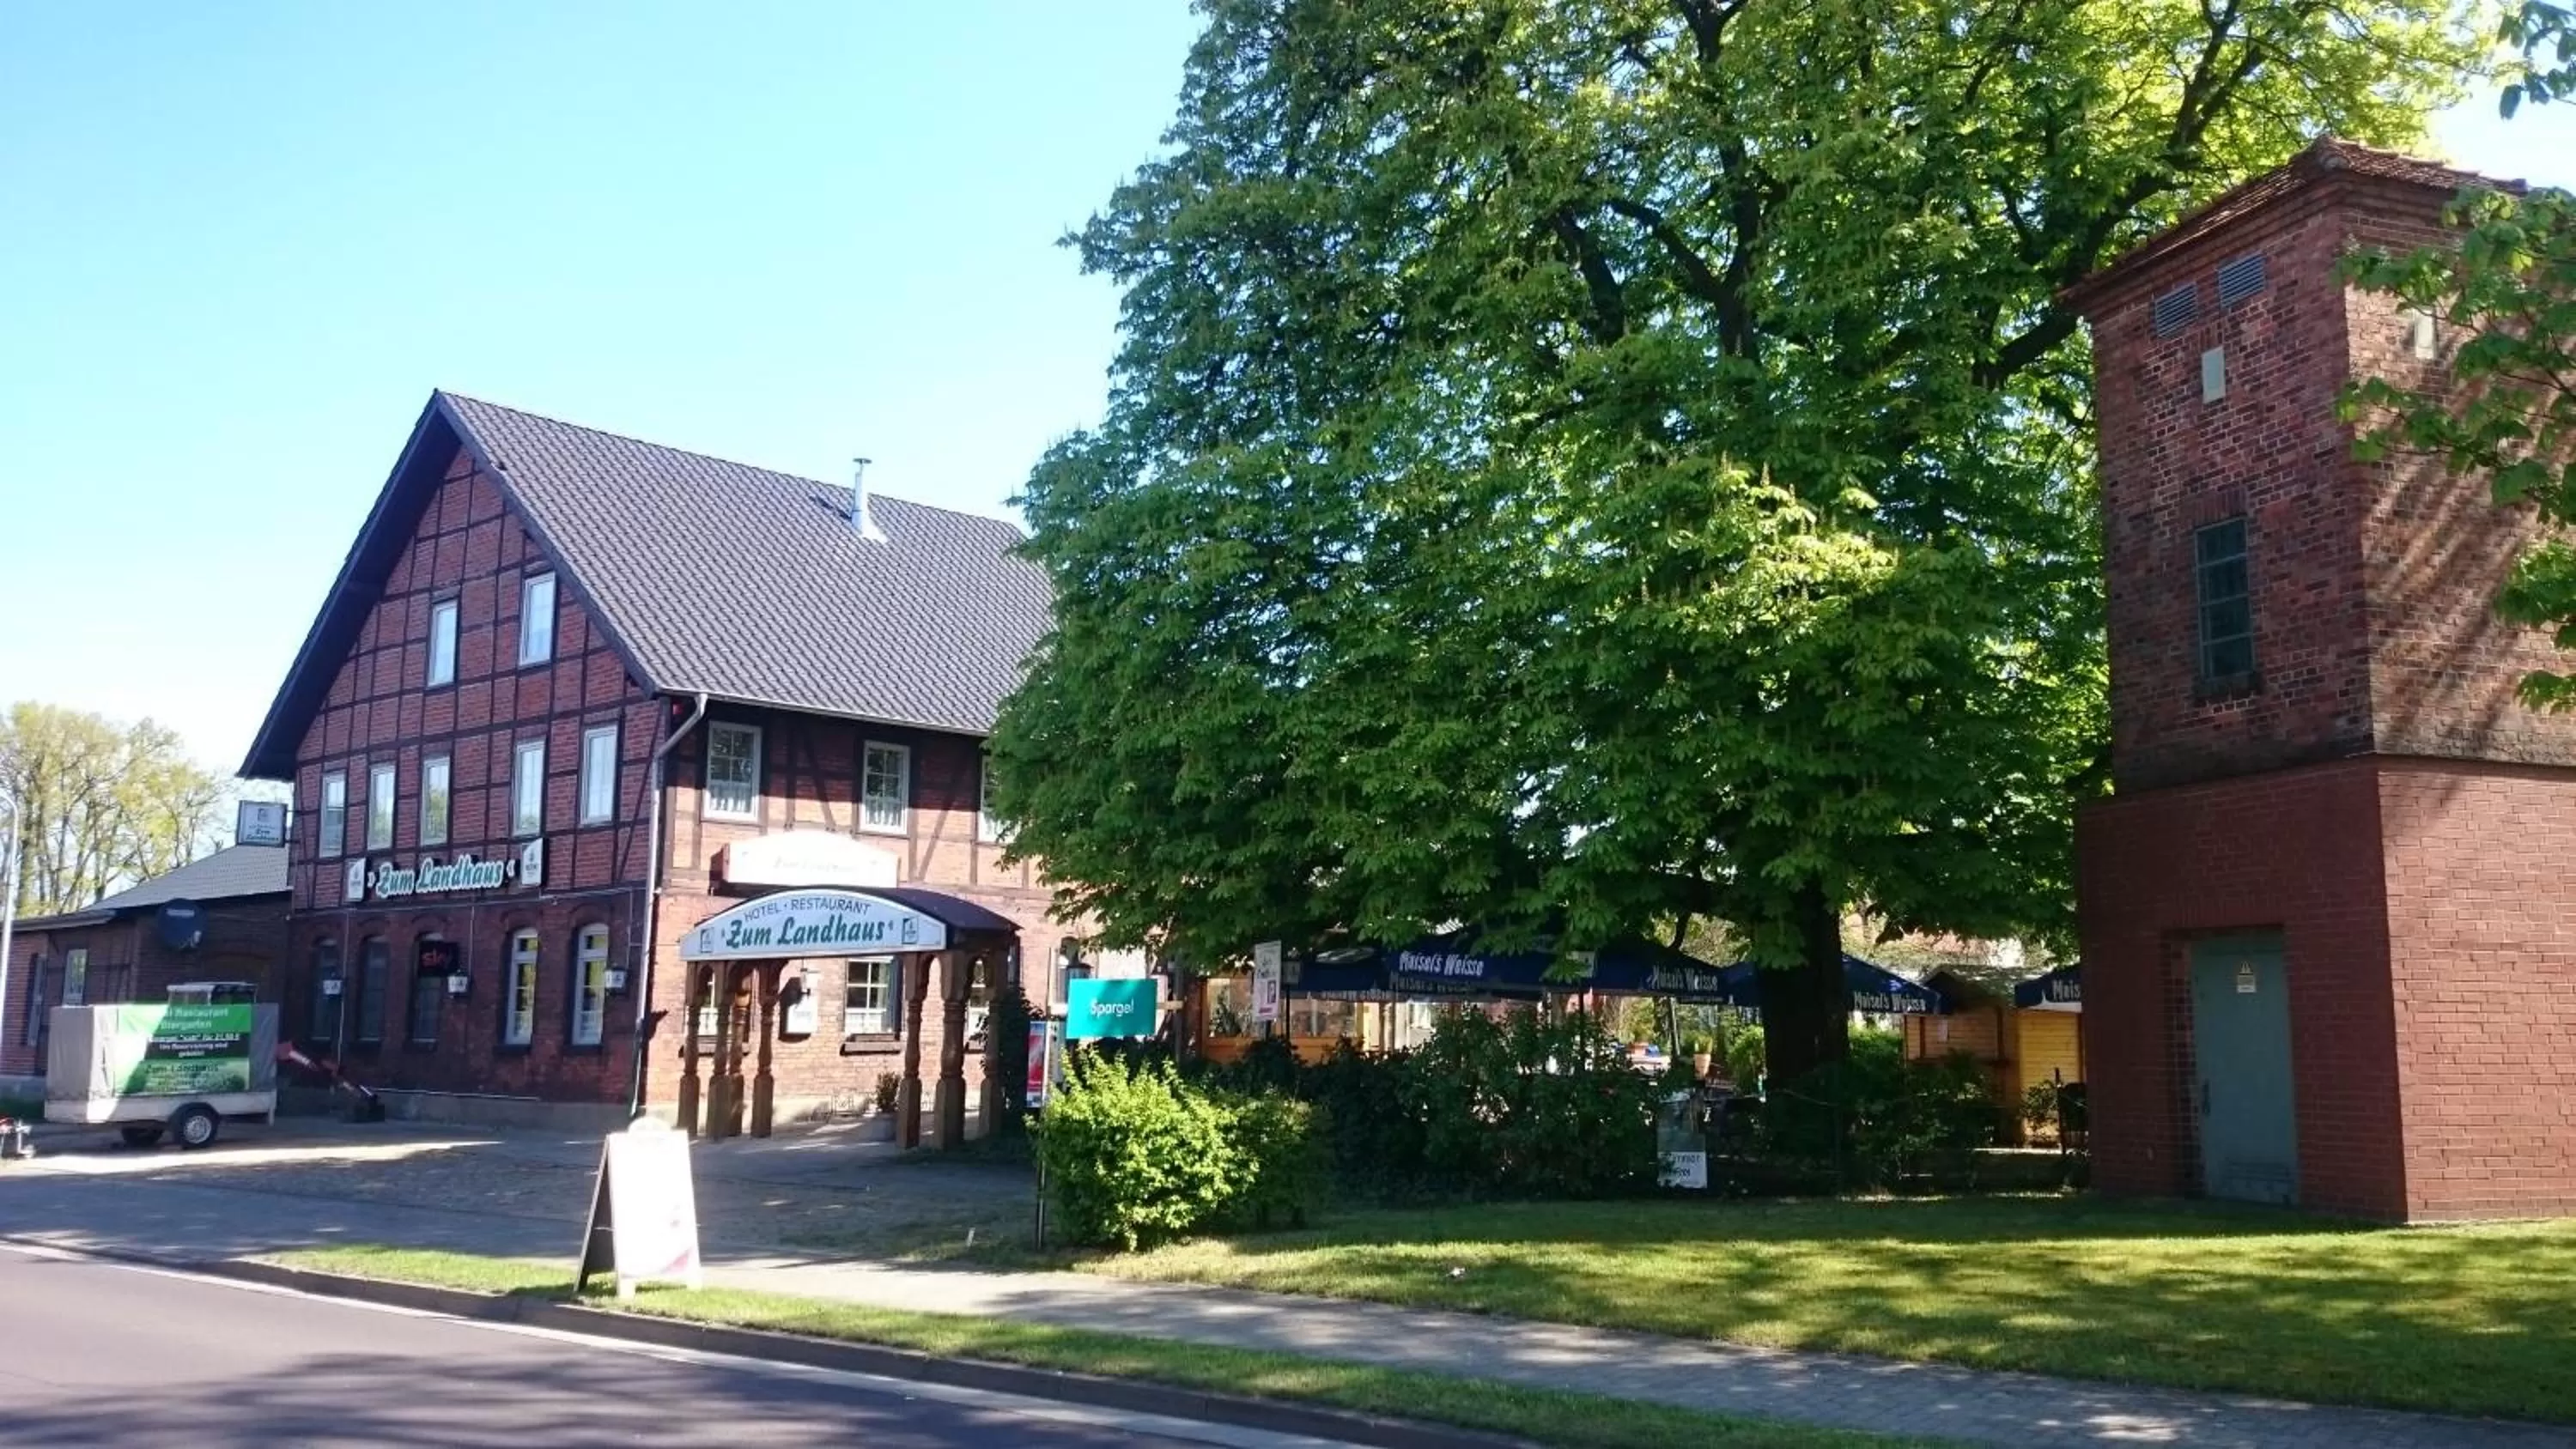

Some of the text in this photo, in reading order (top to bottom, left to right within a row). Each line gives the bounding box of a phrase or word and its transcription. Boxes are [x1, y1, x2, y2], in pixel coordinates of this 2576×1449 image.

[376, 854, 504, 898] Zum Landhaus
[744, 898, 871, 921] HOTEL RESTAURANT
[726, 914, 886, 949] Zum Landhaus
[1443, 954, 1485, 976] Weisse
[1088, 997, 1135, 1019] Spargel
